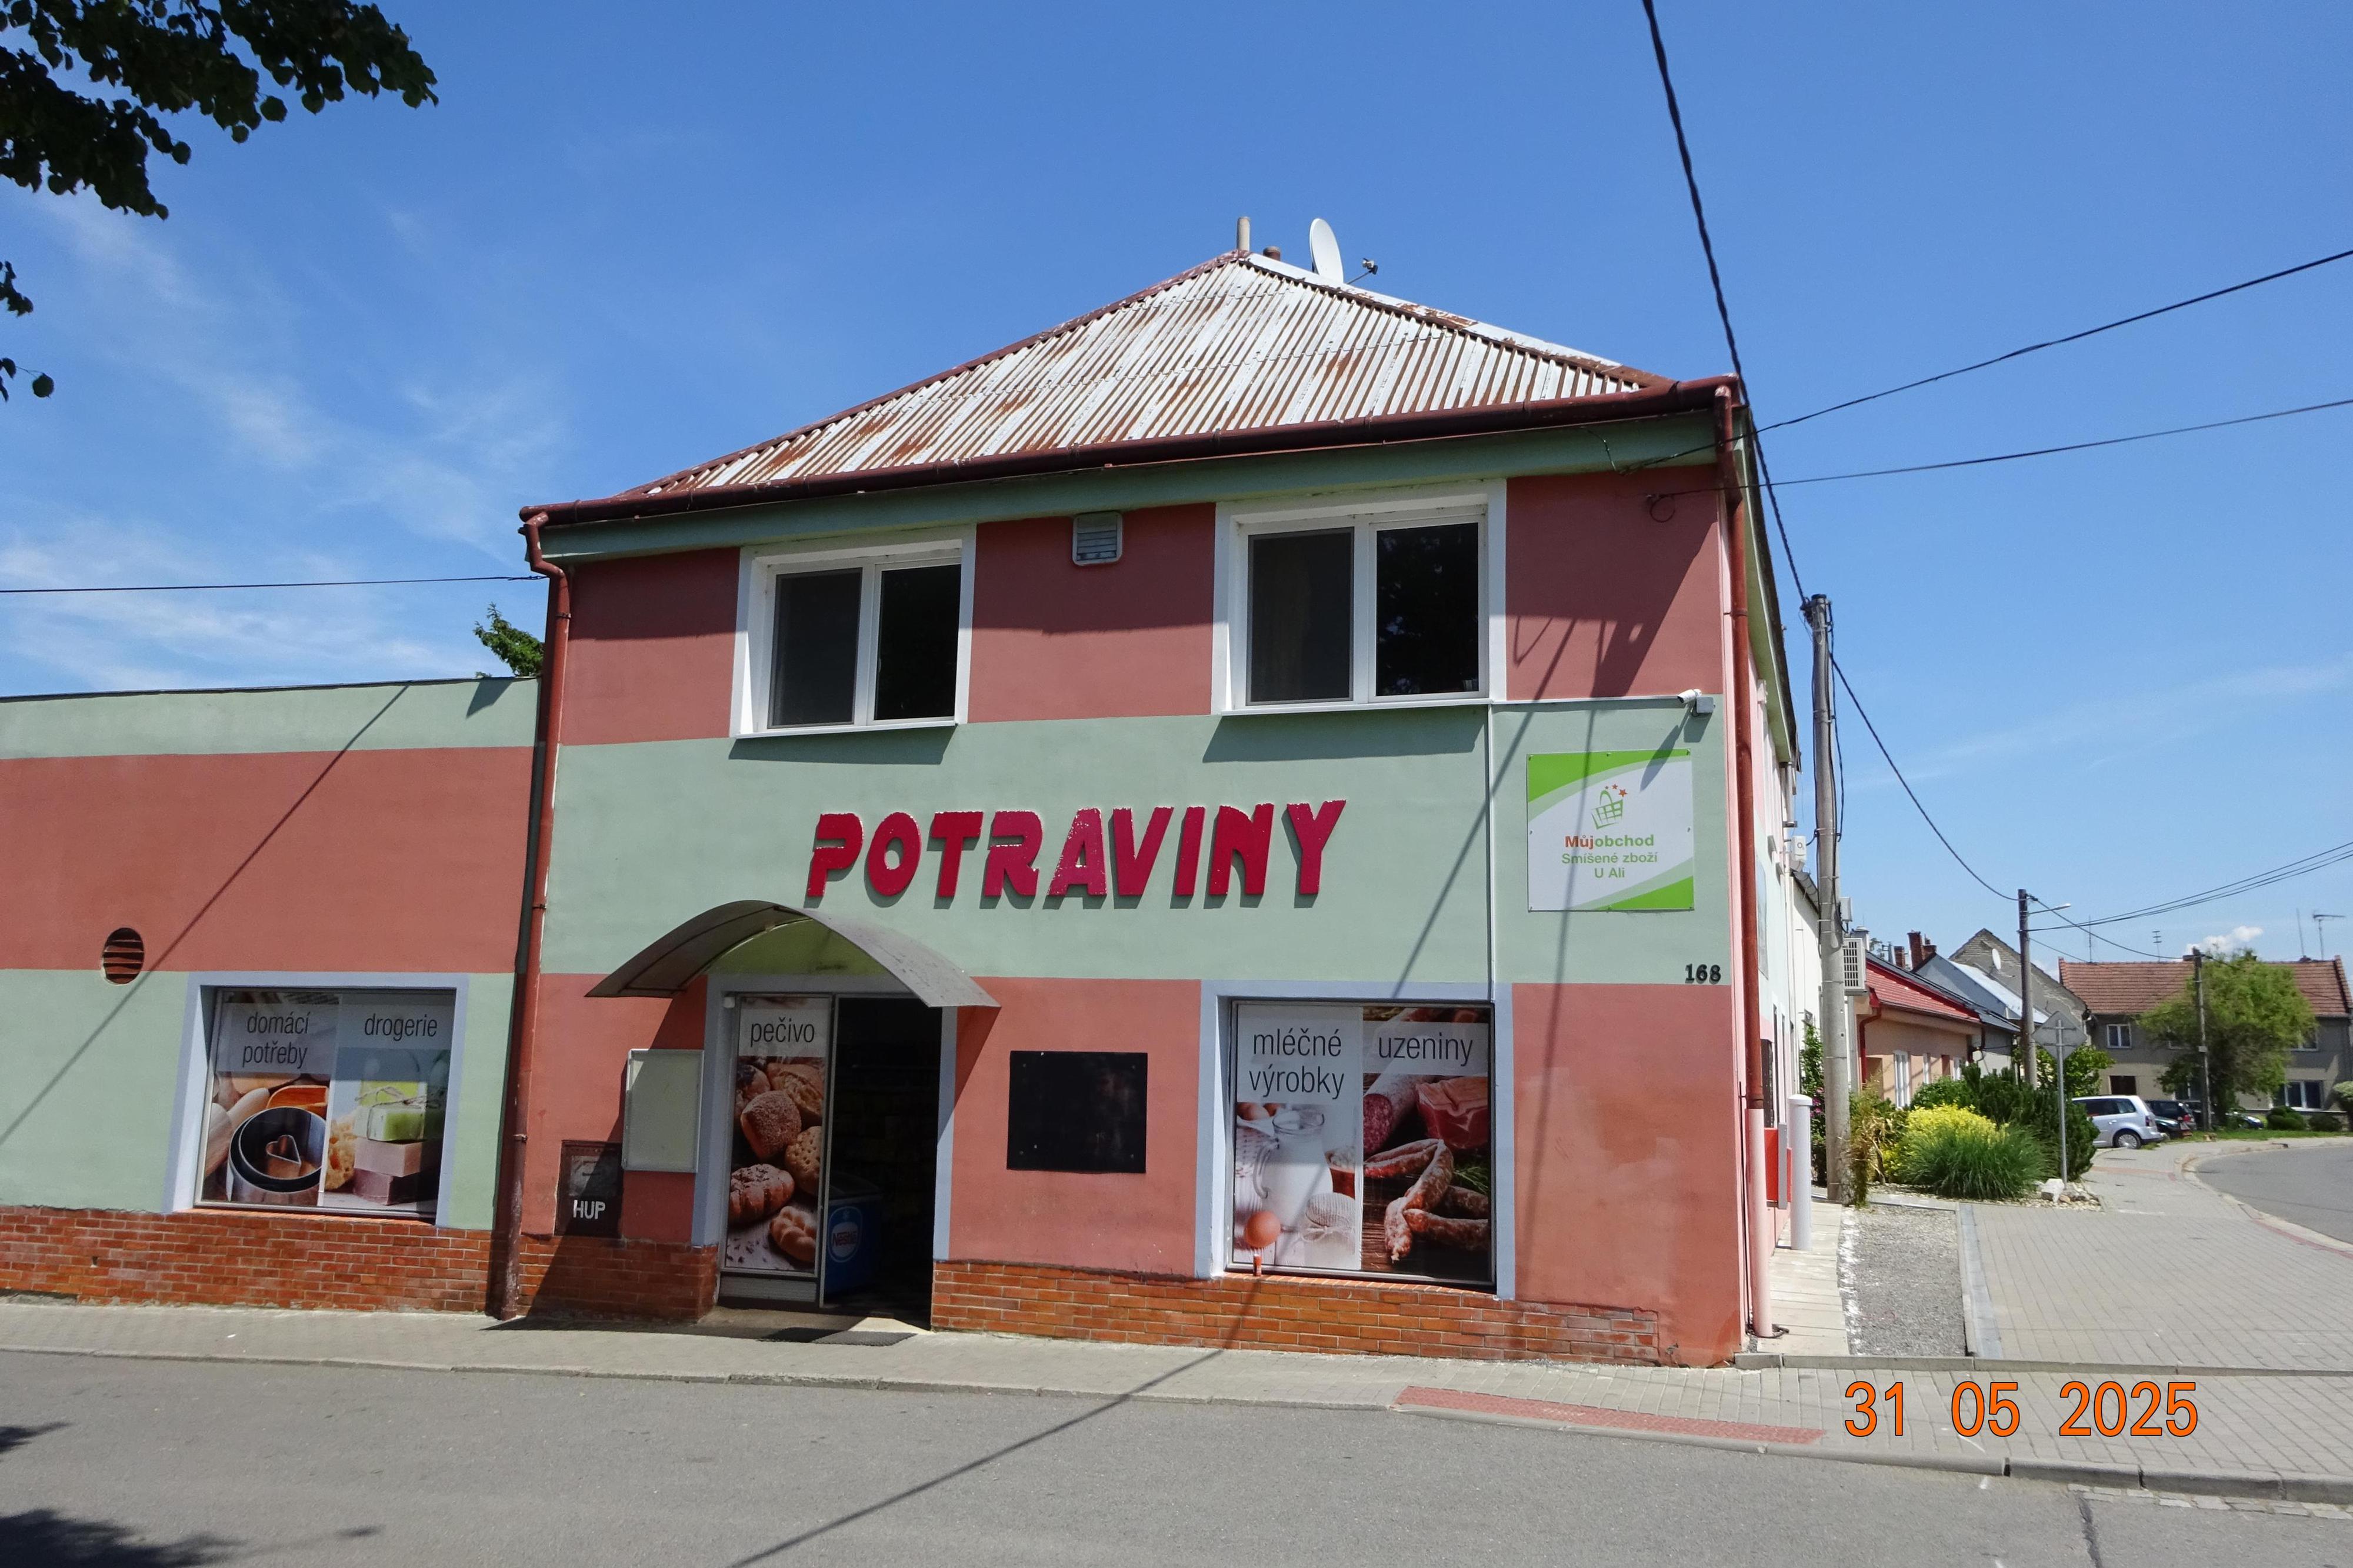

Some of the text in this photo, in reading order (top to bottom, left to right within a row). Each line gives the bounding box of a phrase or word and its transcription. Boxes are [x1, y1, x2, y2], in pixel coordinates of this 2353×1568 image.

[806, 799, 1347, 898] POTRAVINY
[1565, 834, 1654, 849] Můjobchod
[1562, 852, 1658, 864] Smíšené zboží
[1594, 867, 1625, 878] U Ali
[1685, 963, 1721, 982] 168
[246, 1011, 311, 1035] domácí
[364, 1013, 438, 1042] drogerie
[750, 1016, 815, 1047] pečivo
[242, 1040, 308, 1069] potřeby
[1253, 1027, 1342, 1057] mléčné
[1378, 1032, 1473, 1067] uzeniny
[1248, 1063, 1345, 1100] výrobky
[573, 1199, 606, 1220] HUP
